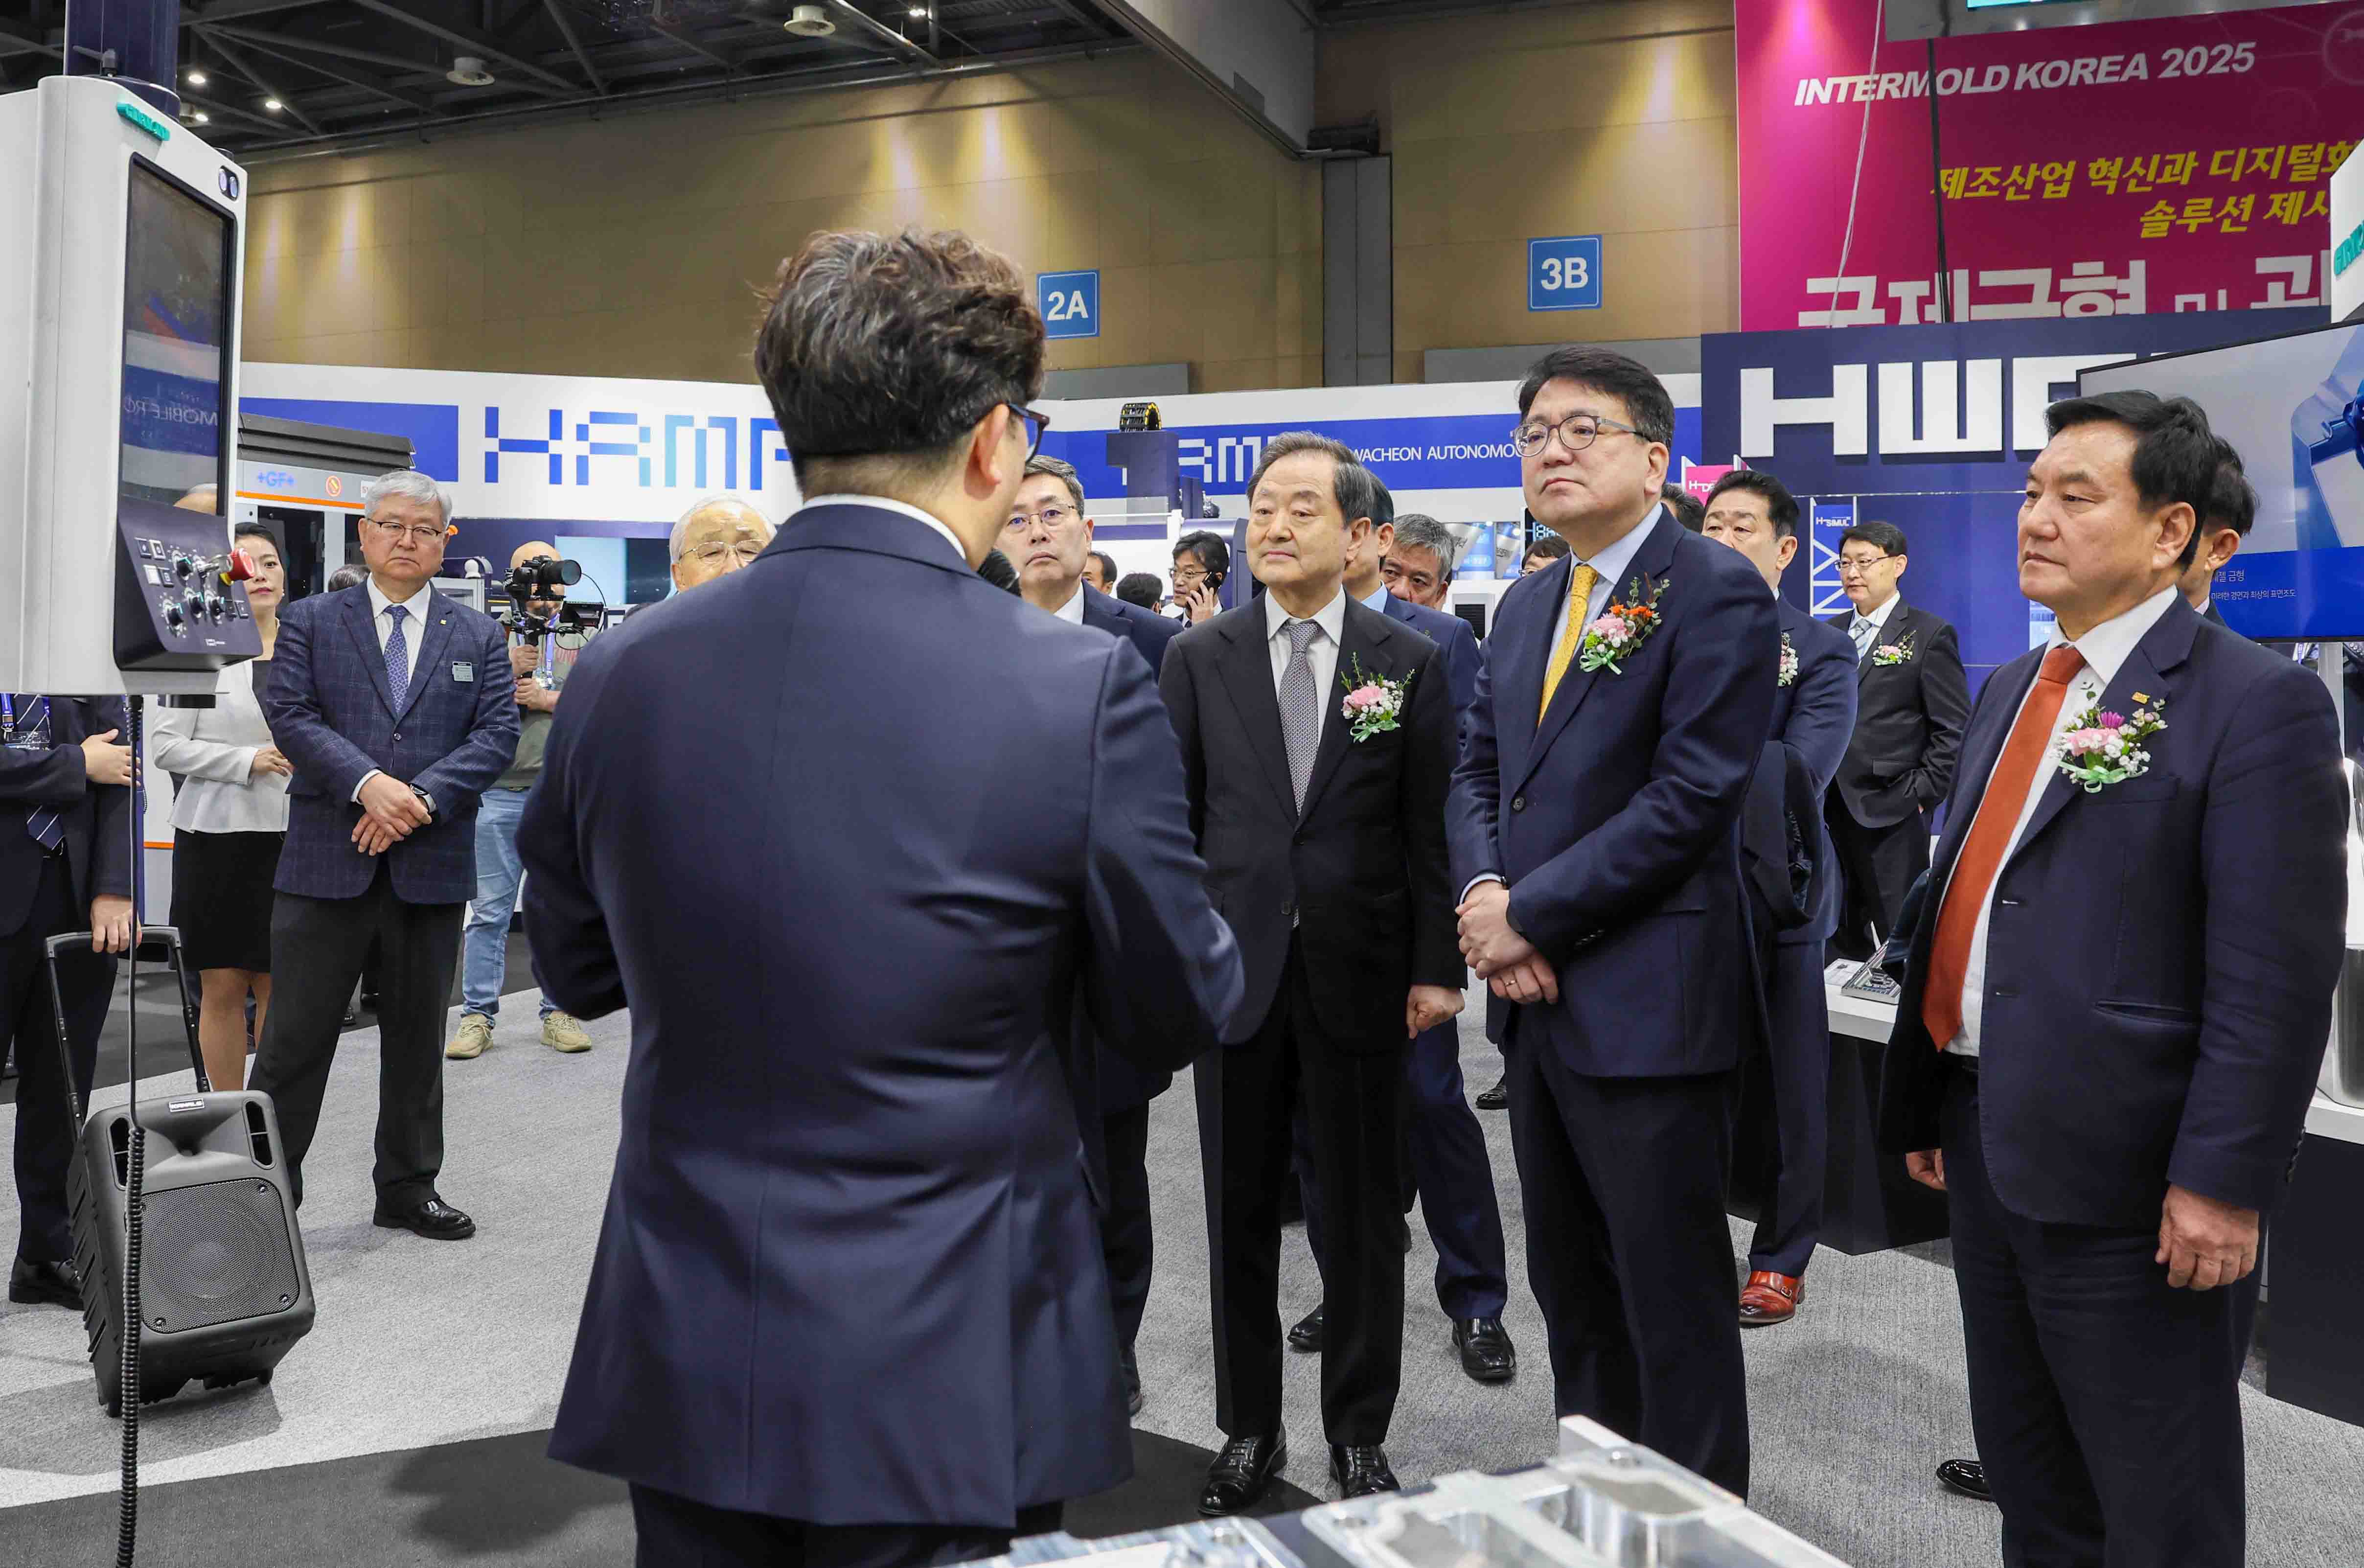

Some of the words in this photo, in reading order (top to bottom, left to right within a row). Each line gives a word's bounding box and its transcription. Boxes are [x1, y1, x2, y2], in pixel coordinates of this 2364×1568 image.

[1794, 65, 2010, 106] INTERMOLD
[2014, 53, 2149, 91] KOREA
[2158, 41, 2257, 78] 2025
[1930, 160, 2076, 201] 제조산업
[2088, 151, 2199, 195] 혁신과
[2140, 194, 2255, 238] 솔루션
[1541, 257, 1588, 290] 3B
[1047, 290, 1089, 321] 2A
[1349, 446, 1422, 462] WACHEON
[2228, 569, 2245, 582] 금형
[2250, 590, 2270, 600] 최상의
